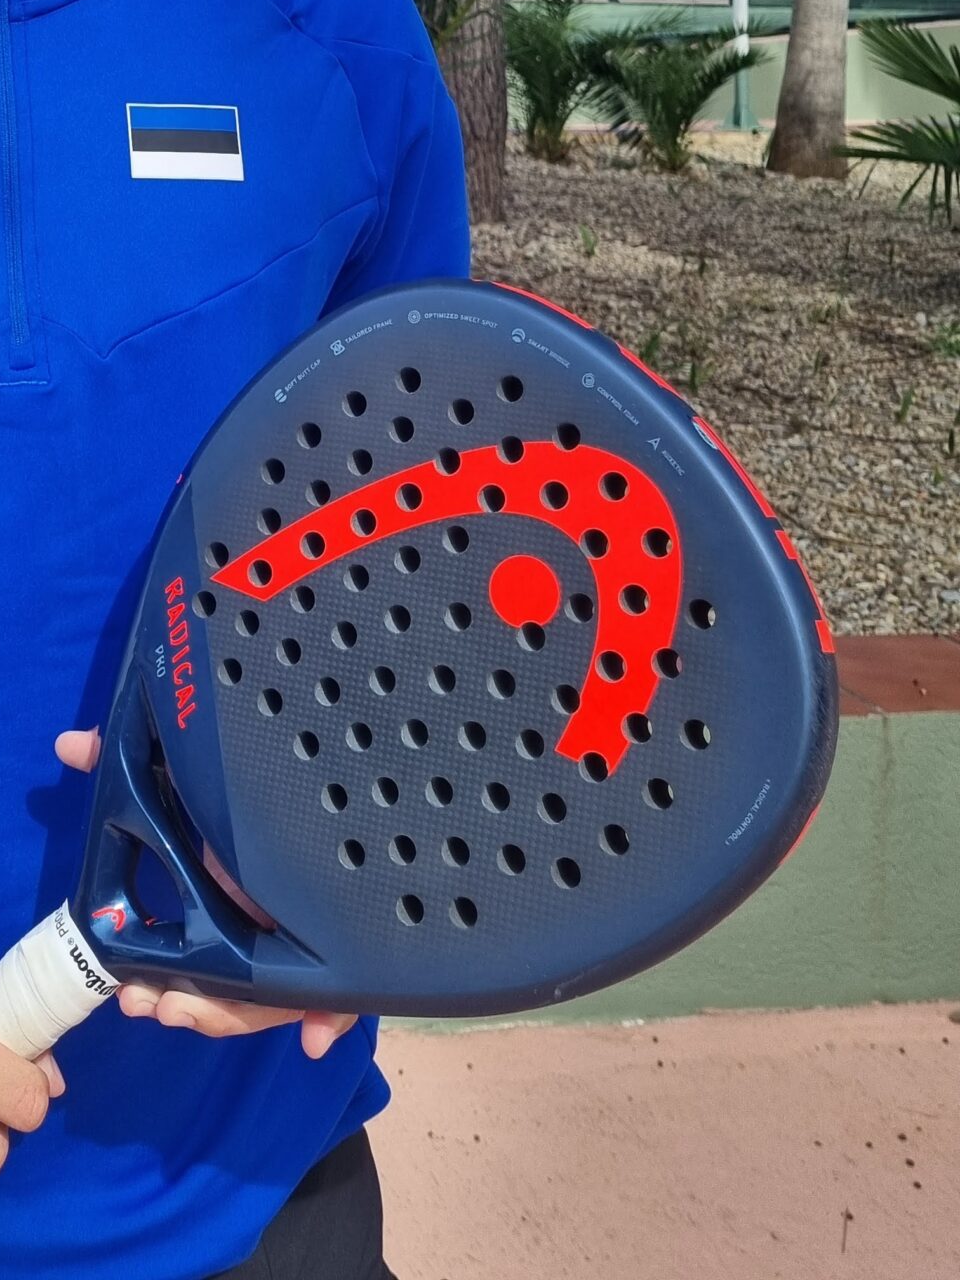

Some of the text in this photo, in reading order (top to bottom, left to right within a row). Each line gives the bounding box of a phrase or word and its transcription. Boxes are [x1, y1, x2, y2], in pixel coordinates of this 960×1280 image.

[424, 312, 459, 320] OPTIMIZED
[345, 326, 373, 344] TAILORED
[154, 644, 167, 679] PRO
[164, 576, 197, 730] RADICAL
[727, 783, 771, 842] RADICAL CONTROL
